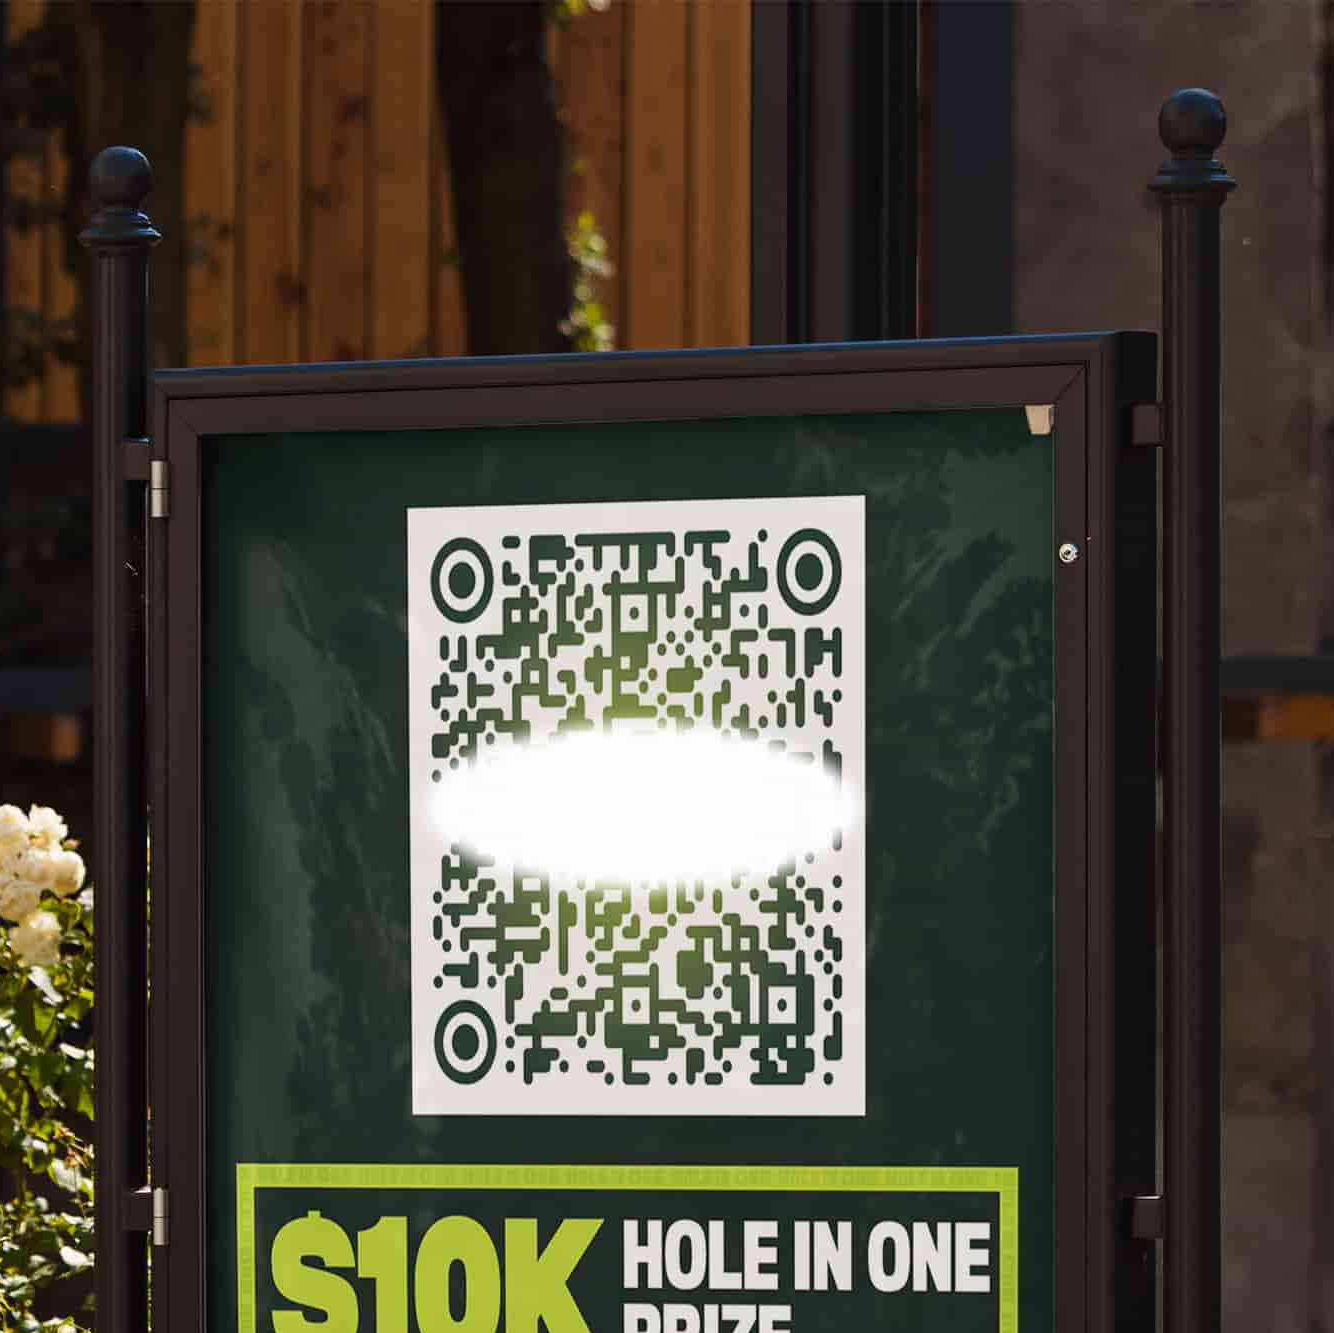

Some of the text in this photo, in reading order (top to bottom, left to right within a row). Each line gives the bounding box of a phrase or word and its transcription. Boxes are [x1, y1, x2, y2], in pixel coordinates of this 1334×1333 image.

[623, 1220, 992, 1293] HOLE IN ONE
